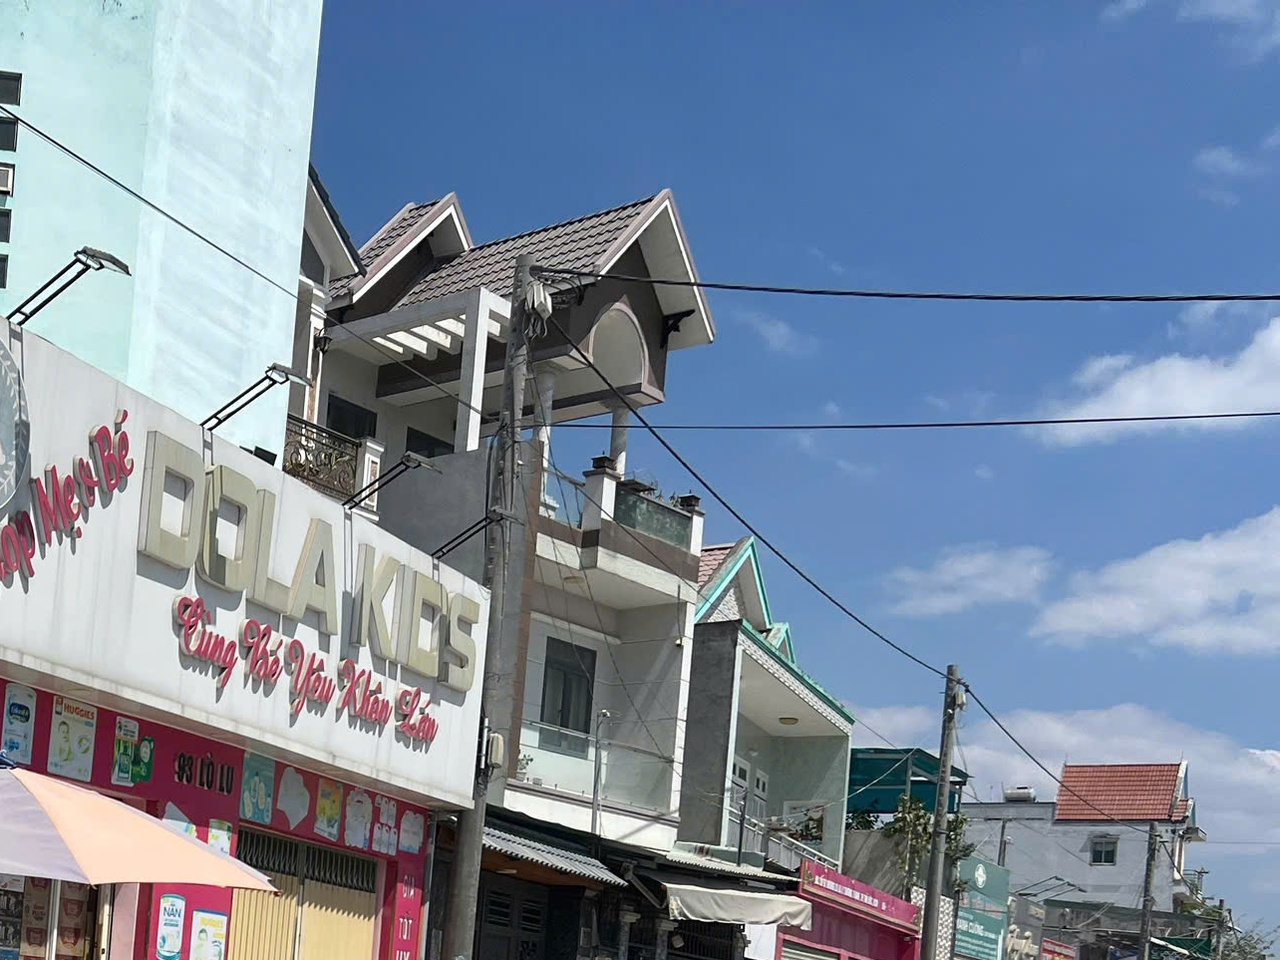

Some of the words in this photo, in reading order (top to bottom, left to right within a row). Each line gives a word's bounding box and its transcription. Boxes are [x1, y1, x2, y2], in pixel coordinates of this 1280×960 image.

[30, 464, 82, 547] Mẹ
[89, 409, 135, 493] Bé
[137, 430, 339, 636] DOLA
[350, 543, 481, 692] KIDS
[63, 703, 95, 720] HUGGIES
[173, 596, 239, 690] Cùng
[239, 619, 284, 682] Bé
[284, 639, 336, 717] Yêu
[337, 658, 394, 727] Khôn
[394, 687, 440, 743] Lớn
[175, 752, 194, 785] 93
[196, 752, 215, 790] LÒ
[217, 763, 234, 796] LU
[163, 906, 181, 918] NAN
